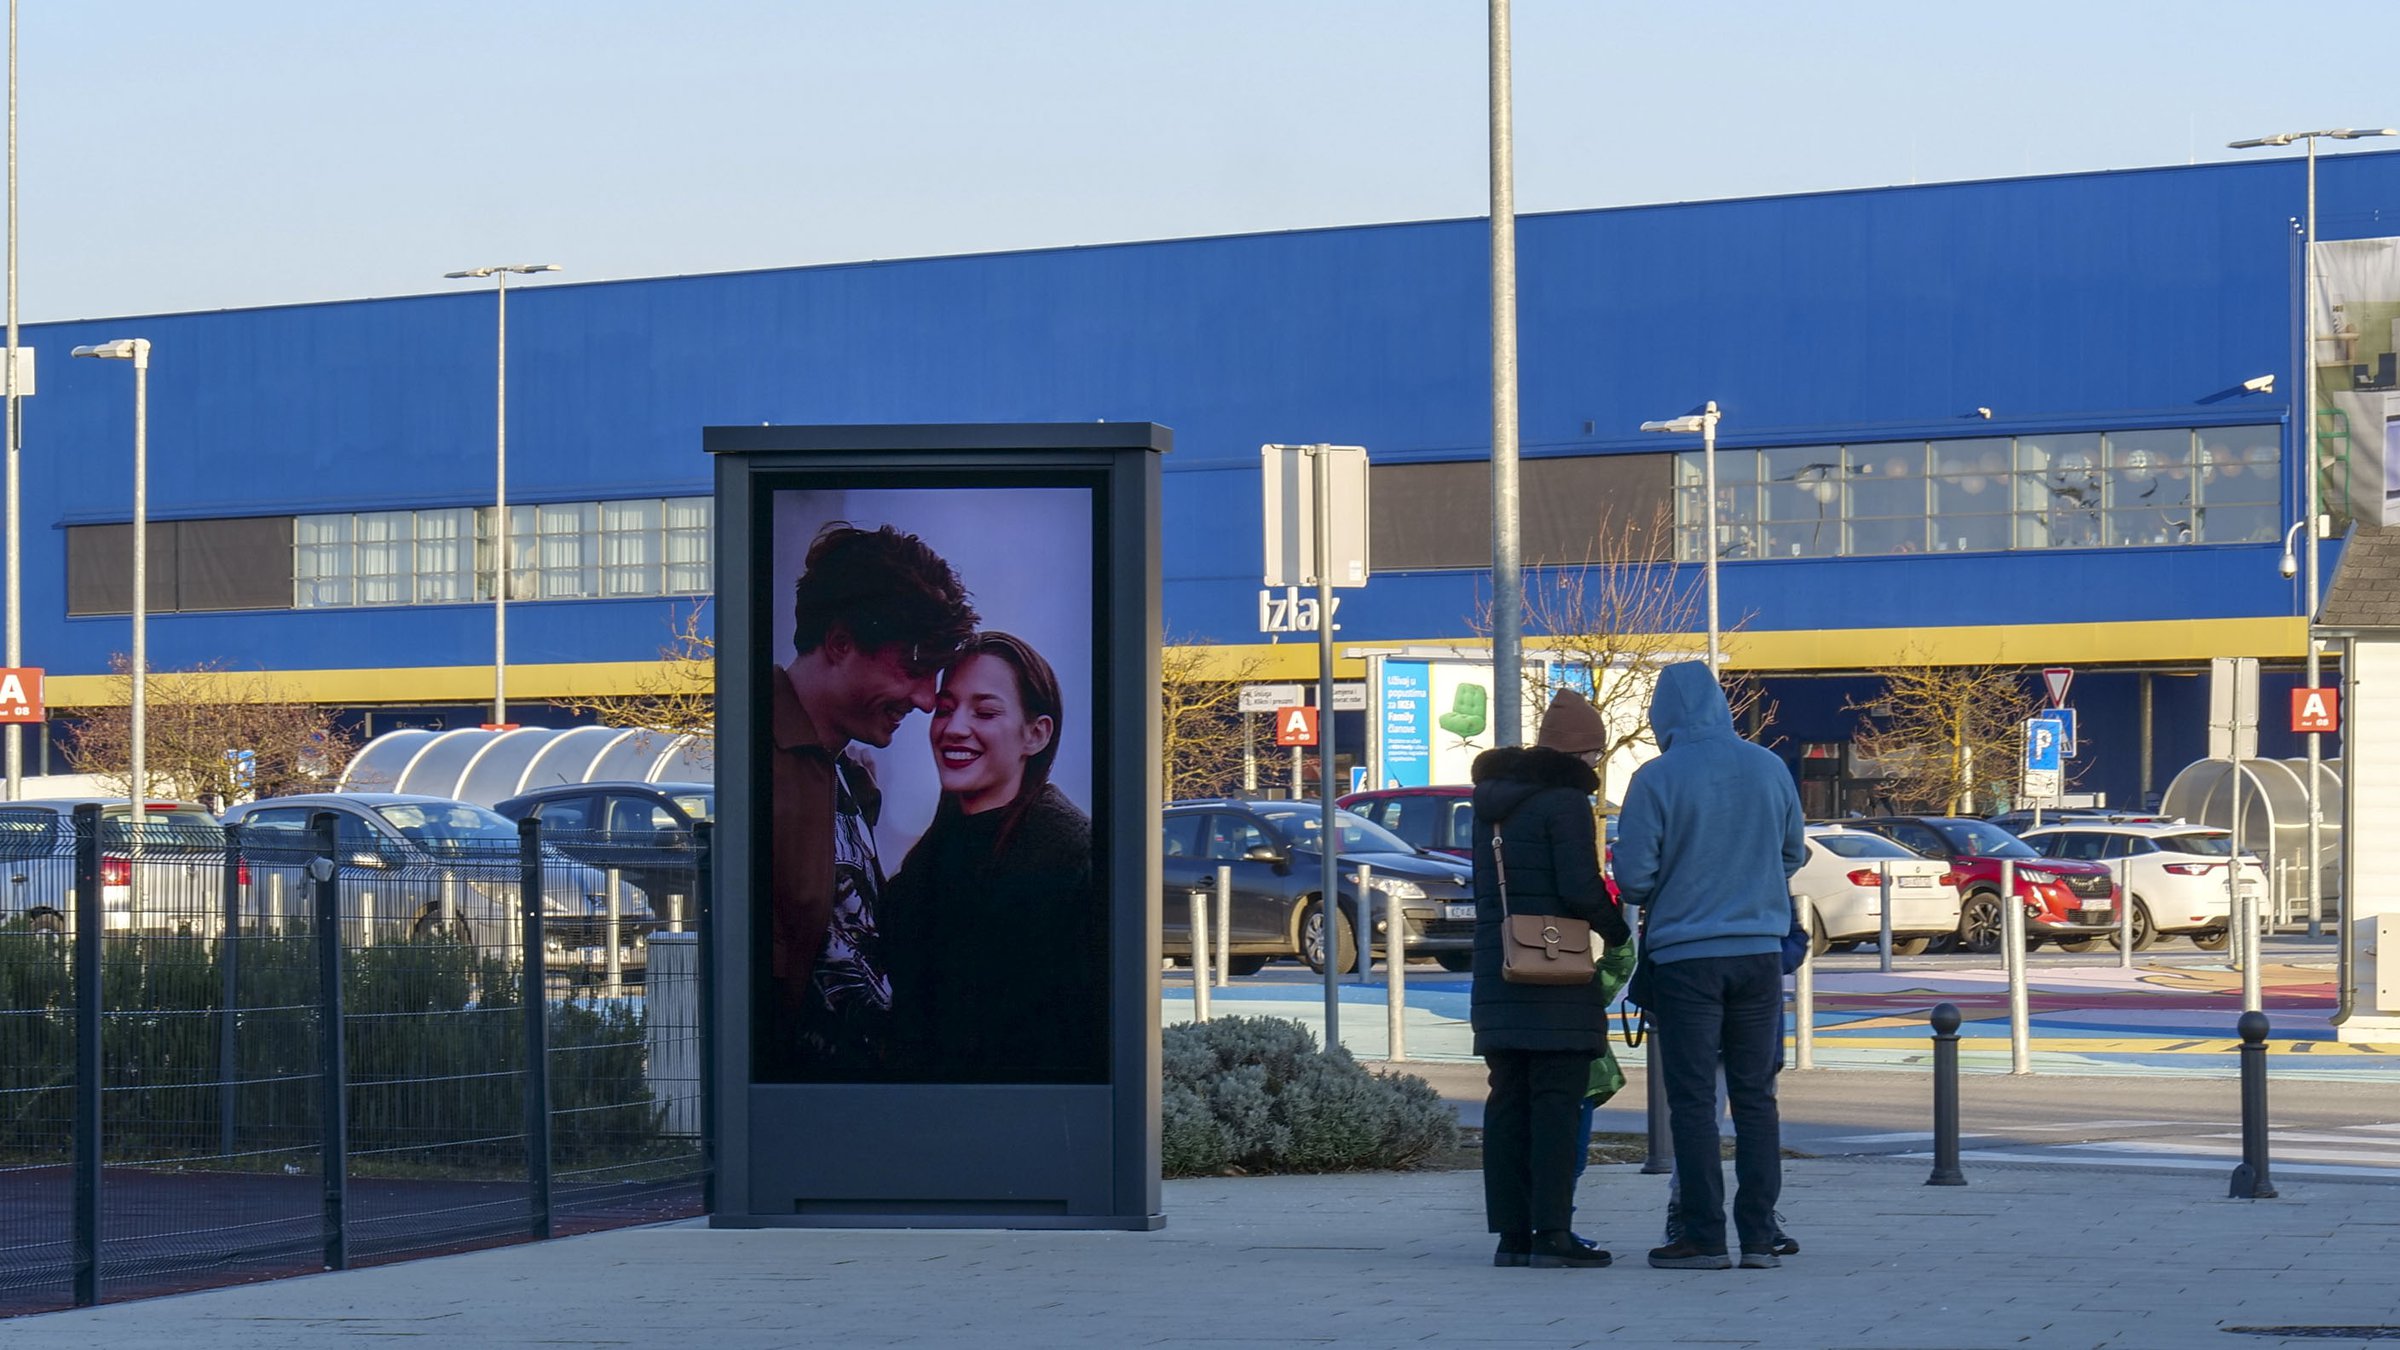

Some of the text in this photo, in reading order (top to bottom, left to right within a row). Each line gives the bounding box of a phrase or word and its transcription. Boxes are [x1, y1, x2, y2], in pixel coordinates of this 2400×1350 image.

[0, 674, 27, 704] A
[2302, 693, 2327, 717] A
[1286, 711, 1308, 732] A
[2035, 729, 2053, 760] P
